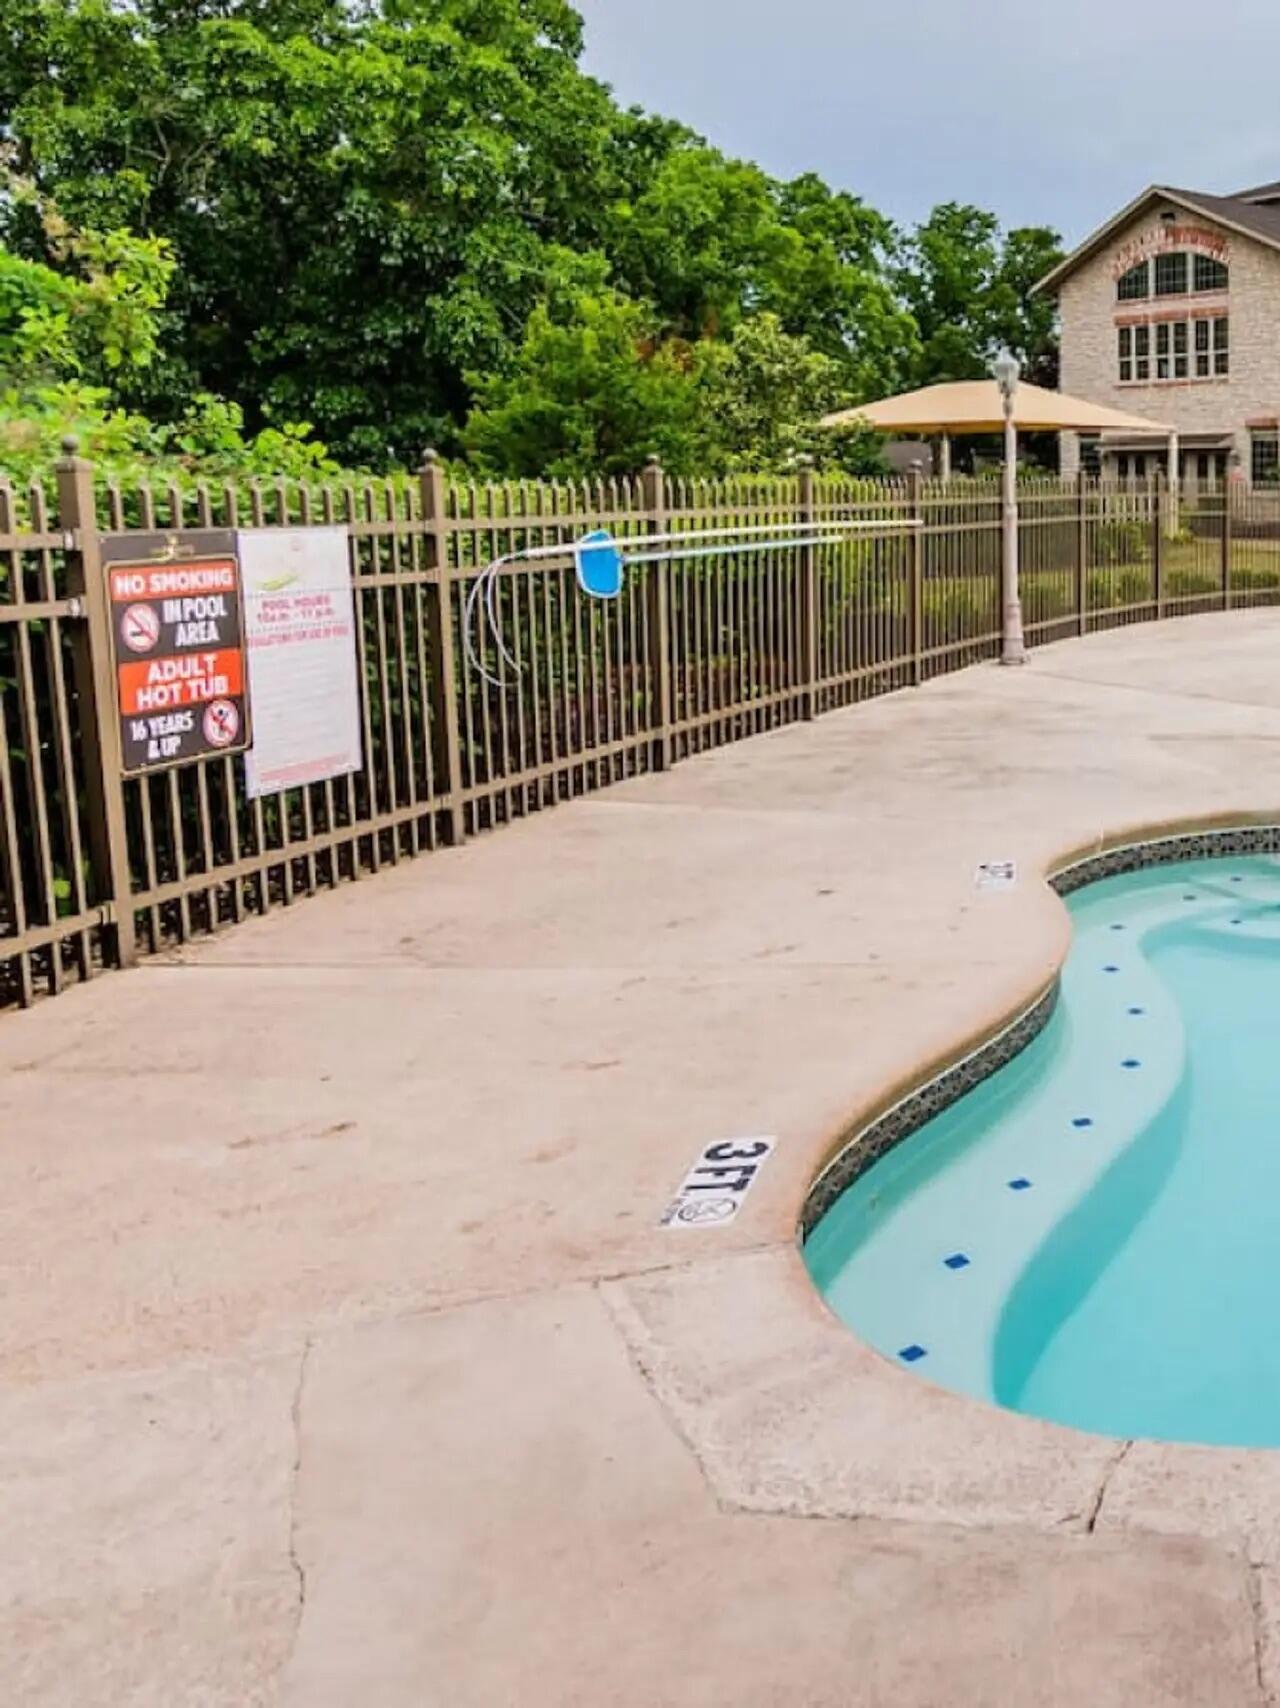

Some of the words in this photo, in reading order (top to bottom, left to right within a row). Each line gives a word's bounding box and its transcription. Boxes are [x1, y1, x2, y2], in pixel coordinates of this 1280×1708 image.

[115, 574, 145, 595] NO
[149, 567, 232, 592] SMOKING
[163, 599, 182, 623] IN
[182, 595, 227, 620] POOL
[175, 620, 219, 647] AREA
[148, 653, 217, 684] ADULT
[137, 682, 181, 711] HOT
[186, 675, 229, 701] TUB
[131, 719, 148, 741] 16
[148, 710, 194, 737] YEARS
[160, 735, 181, 757] UP
